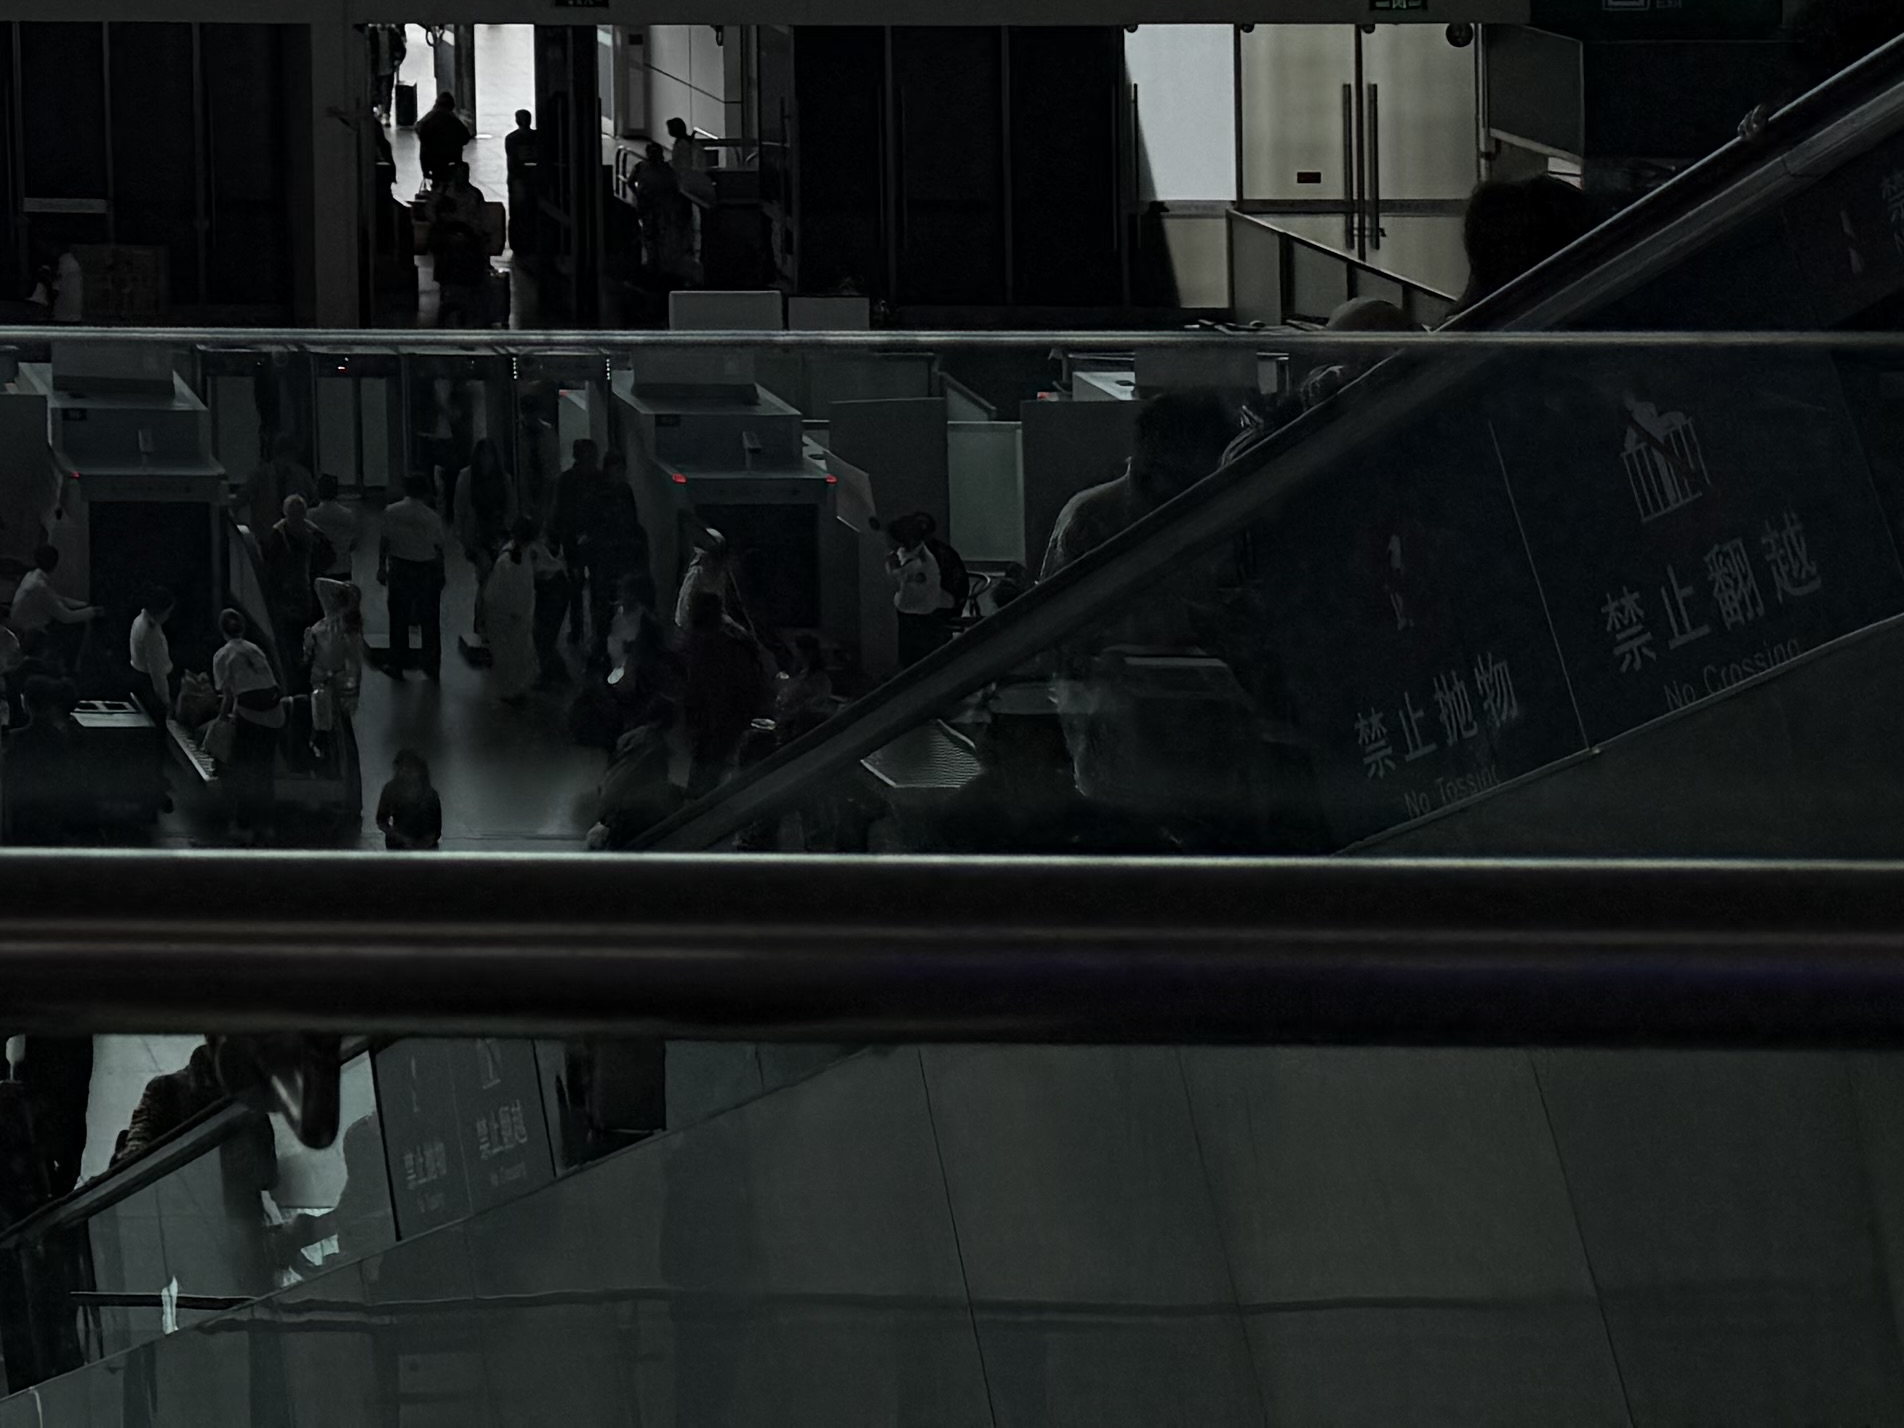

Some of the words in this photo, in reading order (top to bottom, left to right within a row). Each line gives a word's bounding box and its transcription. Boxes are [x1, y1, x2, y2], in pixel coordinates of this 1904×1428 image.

[1600, 509, 1823, 673] 禁止翻越
[1353, 651, 1520, 779] 禁止抛物
[1663, 680, 1694, 710] No
[1403, 790, 1431, 819] No
